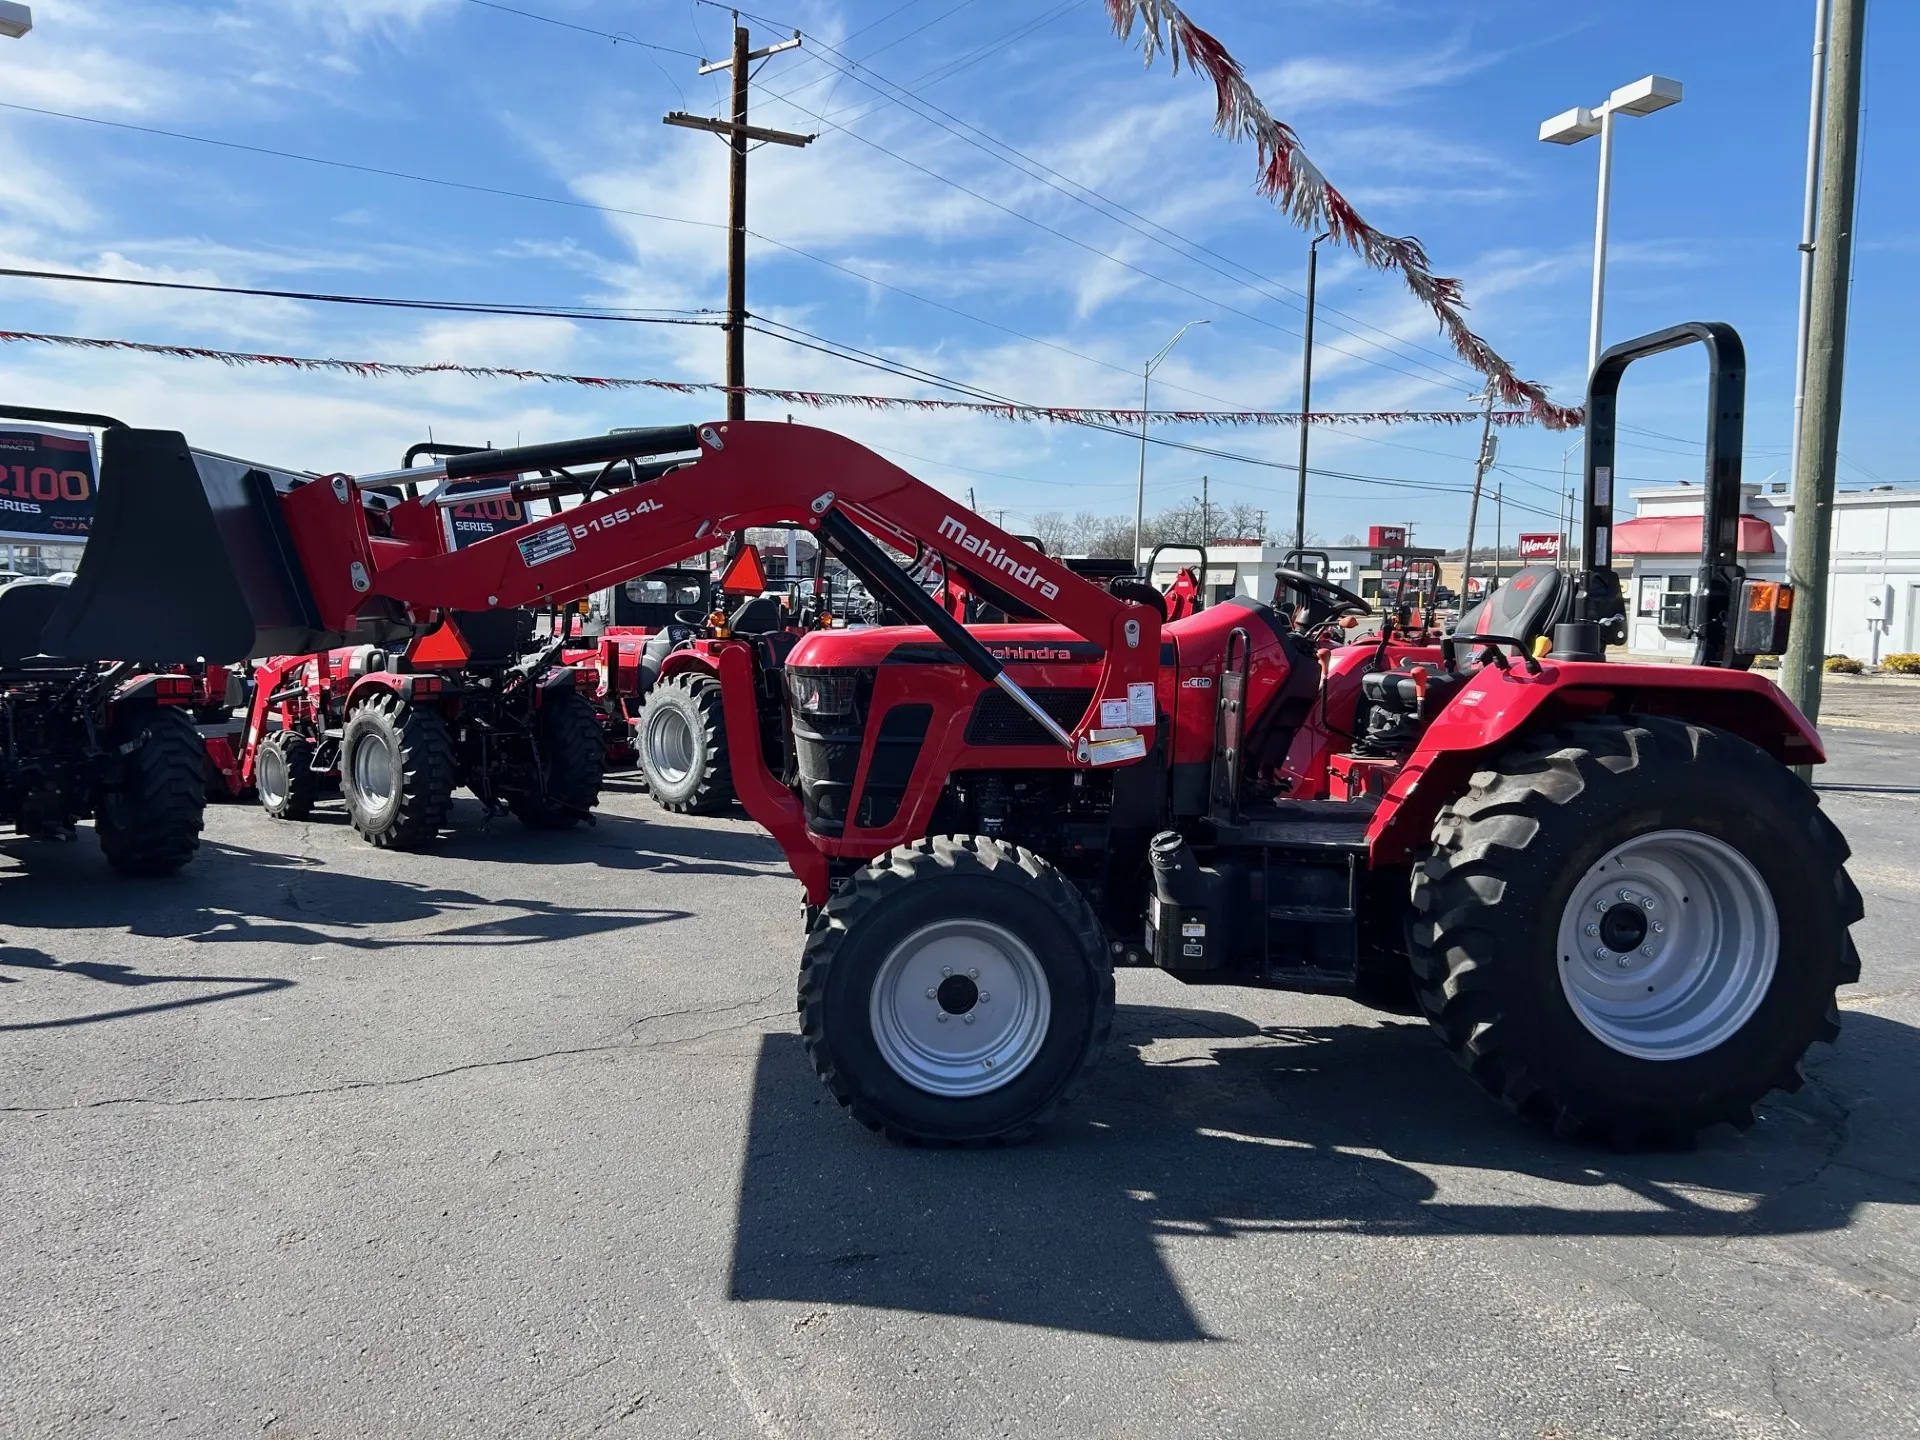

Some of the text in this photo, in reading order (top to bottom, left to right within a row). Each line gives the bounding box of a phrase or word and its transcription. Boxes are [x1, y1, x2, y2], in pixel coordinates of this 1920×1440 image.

[455, 521, 494, 532] SERIES
[572, 499, 664, 539] 5155-4L
[937, 514, 1060, 601] Mahindra
